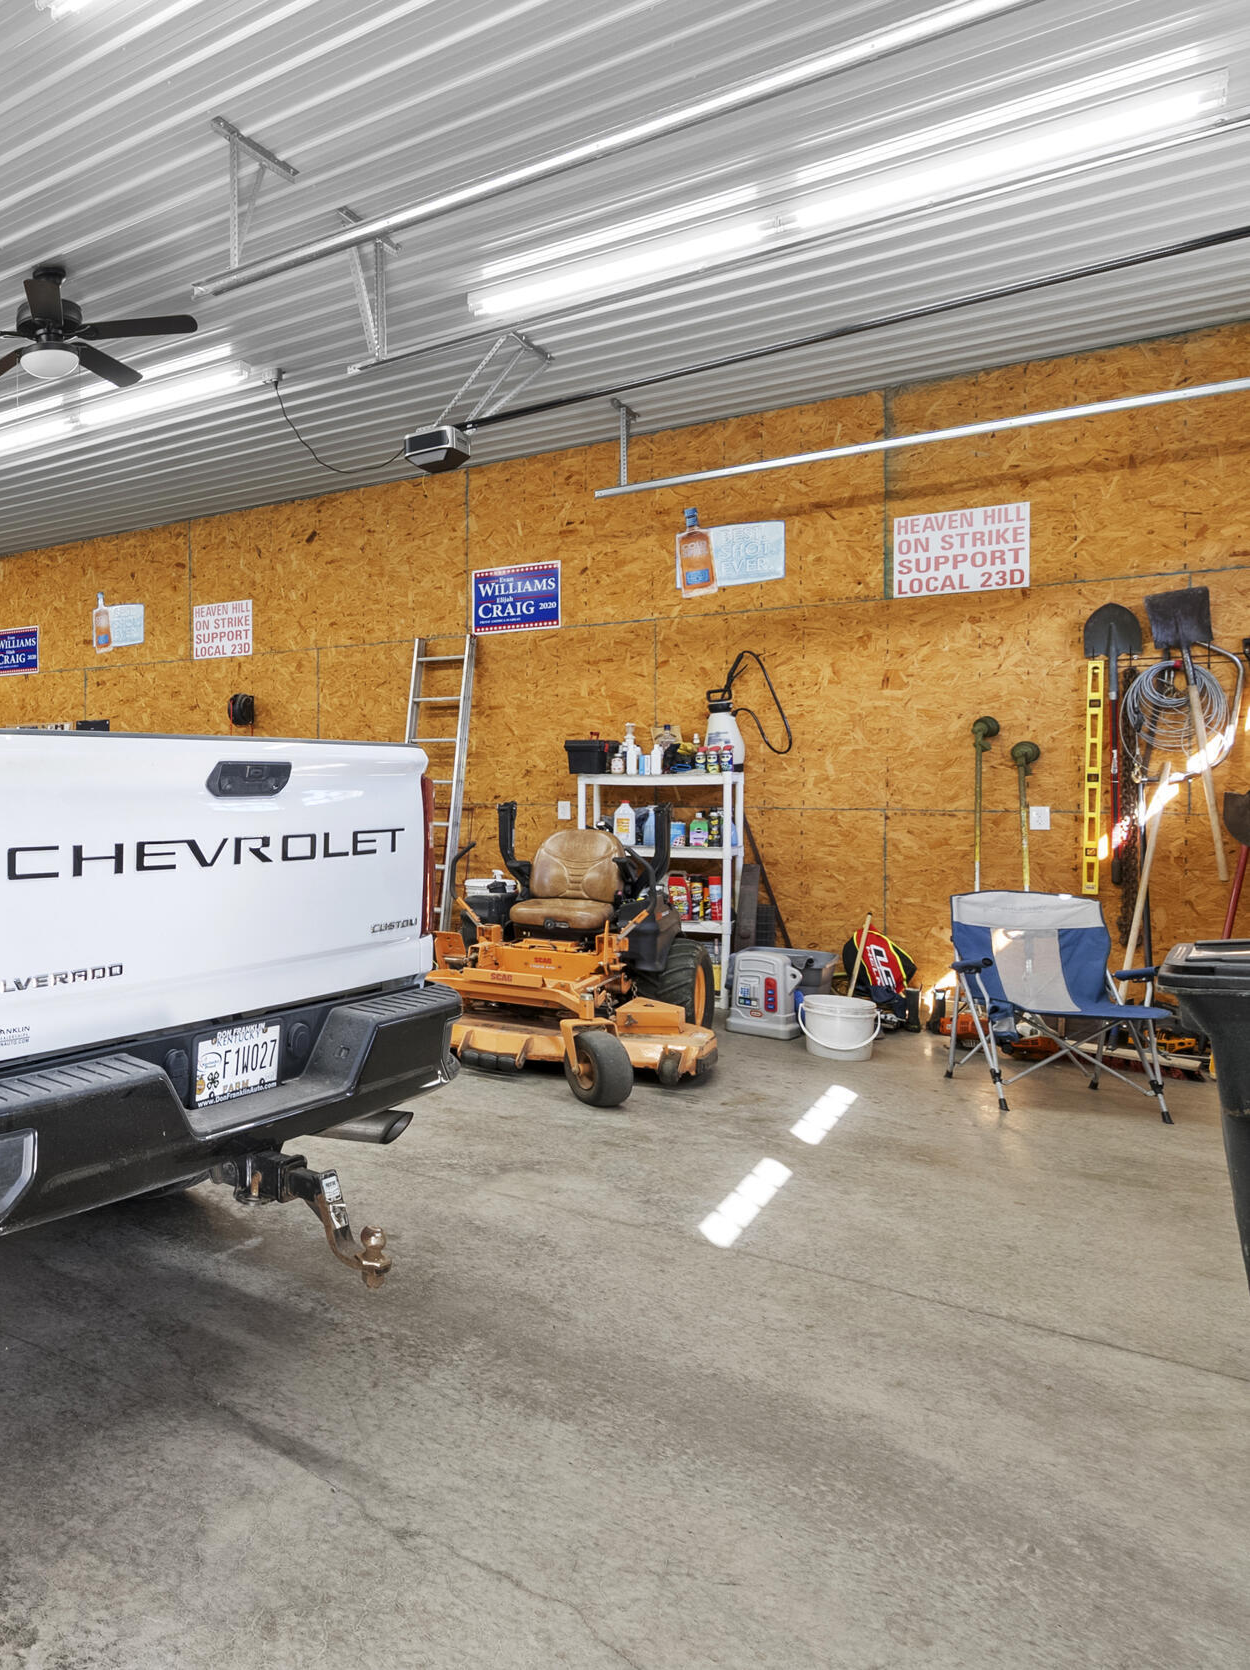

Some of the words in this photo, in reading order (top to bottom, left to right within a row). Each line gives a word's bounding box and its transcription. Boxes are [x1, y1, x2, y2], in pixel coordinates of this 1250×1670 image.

[897, 511, 974, 535] HEAVEN
[983, 506, 1026, 526] HILL
[898, 537, 930, 555] ON
[940, 526, 1025, 551] STRIKE
[897, 547, 1025, 575] SUPPORT
[478, 577, 556, 597] WILLIAMS
[897, 574, 970, 595] LOCAL
[980, 568, 1025, 588] 23D
[478, 600, 535, 618] CRAIG
[538, 601, 557, 610] 2020
[496, 596, 514, 604] Elijah
[195, 603, 229, 618] HEAVEN
[232, 601, 250, 614] HILL
[195, 620, 210, 631] ON
[214, 615, 250, 629] STRIKE
[195, 629, 250, 644] SUPPORT
[195, 645, 227, 657] LOCAL
[231, 642, 251, 655] 23D
[7, 828, 406, 881] CHEVROLET
[490, 972, 513, 982] SCAG
[216, 1029, 233, 1040] DON
[233, 1022, 266, 1037] FRANKLIN
[222, 1039, 277, 1079] F1W027
[197, 1082, 277, 1108] www.DonFranklinAuto.com
[222, 1079, 250, 1094] FARM
